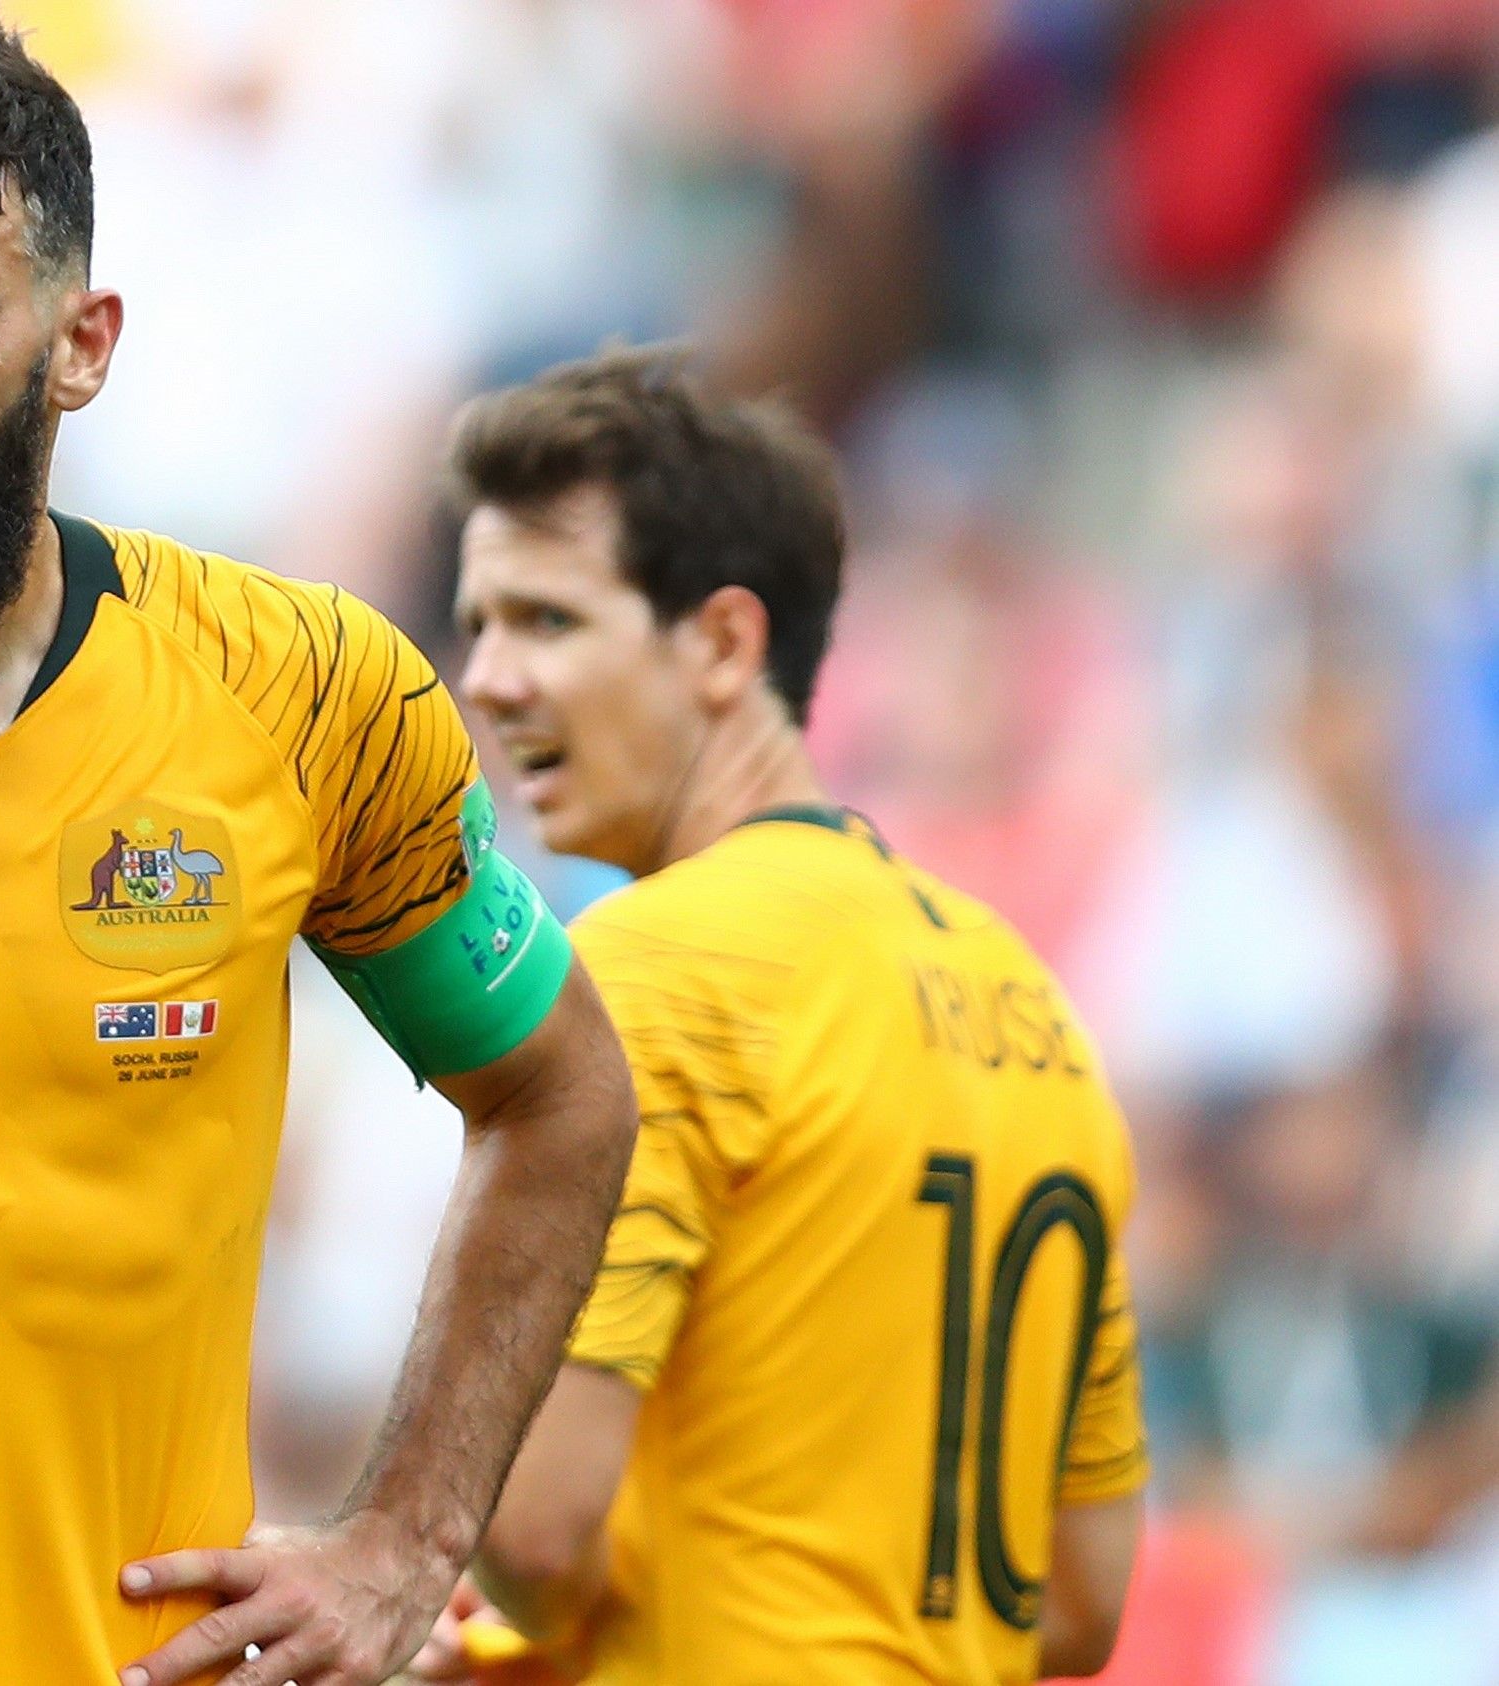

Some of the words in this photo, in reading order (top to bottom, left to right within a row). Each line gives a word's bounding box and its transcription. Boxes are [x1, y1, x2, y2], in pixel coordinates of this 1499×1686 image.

[95, 908, 211, 926] AUSTRALIA
[160, 1050, 199, 1064] RUSSIA
[136, 1068, 168, 1081] JUNE
[918, 1152, 1110, 1629] 10
